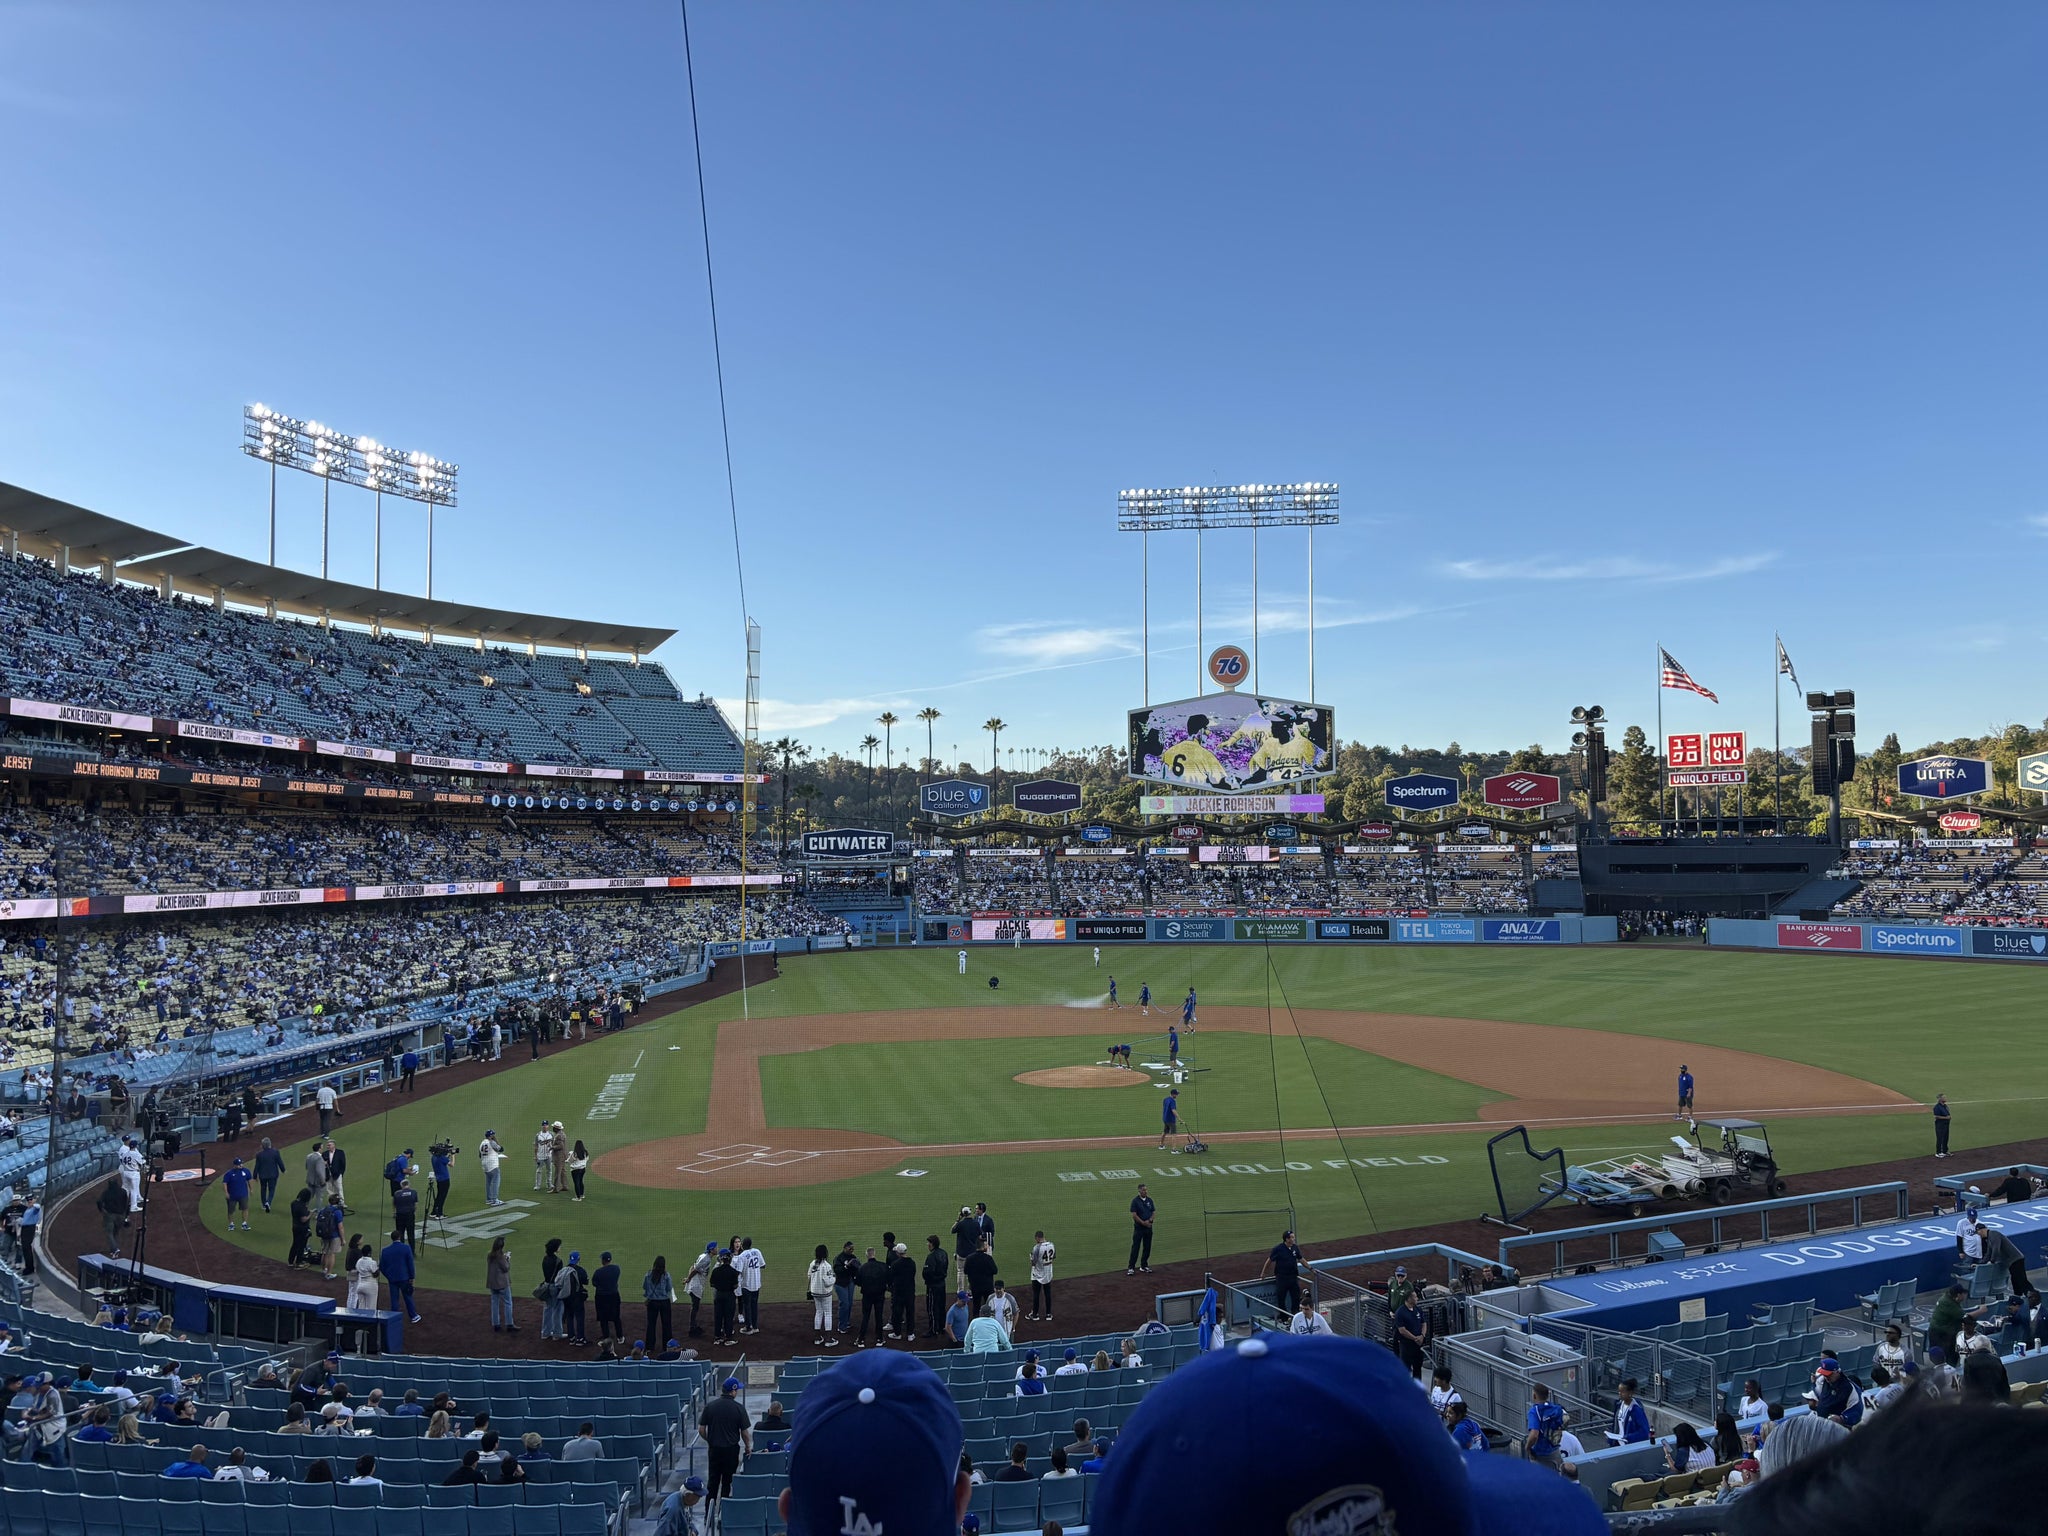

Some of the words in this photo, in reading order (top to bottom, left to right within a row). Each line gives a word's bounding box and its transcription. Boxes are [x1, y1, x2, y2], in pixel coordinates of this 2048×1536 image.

[1216, 656, 1241, 675] 76
[58, 707, 81, 721] JACKIE
[81, 709, 112, 725] ROBINSON
[182, 724, 205, 737] JACKIE
[204, 726, 234, 740] ROBINSON
[1672, 738, 1697, 750] ユニ
[1713, 736, 1737, 748] UNI
[343, 746, 357, 757] JACKIE
[356, 748, 373, 758] ROBINSON
[1672, 751, 1698, 762] クロ
[1714, 750, 1740, 762] QLO
[2, 756, 33, 770] JERSEY
[414, 755, 429, 765] JACKIE
[428, 757, 451, 768] ROBINSON
[1172, 754, 1187, 777] 6
[73, 762, 99, 776] JACKIE
[99, 764, 134, 778] ROBINSON
[134, 767, 160, 780] JERSEY
[555, 767, 570, 776] JACKIE
[571, 768, 592, 777] ROBINSON
[648, 772, 668, 780] JACKIE
[668, 773, 694, 781] ROBINSON
[1916, 768, 1968, 780] ULTRA
[190, 772, 211, 784] JACKIE
[211, 774, 240, 787] ROBINSON
[239, 776, 262, 788] JERSEY
[1673, 775, 1709, 785] UNIQLO
[1712, 773, 1742, 782] FIELD
[287, 781, 304, 792] JACKIE
[327, 784, 345, 795] JERSEY
[927, 787, 965, 802] blue
[1392, 786, 1448, 799] Spectrum
[1019, 793, 1077, 801] GUGGENHEIM
[1186, 797, 1223, 811] JACKIE
[1223, 797, 1276, 811] ROBINSON
[1942, 816, 1979, 828] Churu
[808, 836, 887, 851] CUTWATER
[1218, 846, 1246, 854] JACKIE
[1217, 853, 1247, 861] ROBINSON
[537, 881, 550, 890] JACKIE
[608, 879, 623, 888] JACKIE
[258, 892, 277, 904] JACKIE
[276, 890, 301, 903] ROBINSON
[382, 886, 401, 898] JACKIE
[400, 885, 425, 896] ROBINSON
[155, 896, 177, 911] JACKIE
[177, 894, 207, 909] ROBINSON
[996, 920, 1030, 930] JACKIE
[1093, 926, 1121, 935] UNIQLO
[1121, 926, 1144, 934] FIELD
[1183, 921, 1213, 932] Security
[1325, 926, 1347, 934] UCLA
[1351, 925, 1384, 935] Health
[1399, 923, 1434, 938] TEL
[1498, 923, 1530, 934] ANA
[1785, 924, 1806, 932] BANK
[1817, 925, 1853, 933] AMERICA
[950, 928, 962, 937] 76
[994, 929, 1031, 940] ROBINON
[1876, 930, 1951, 948] Spectrum
[1994, 933, 2029, 949] blue
[1152, 1161, 1313, 1178] UNIQLO
[1321, 1154, 1450, 1170] FIELD
[1042, 1248, 1054, 1262] 42
[1672, 1262, 1748, 1280] ようこそ
[1760, 1225, 1957, 1267] DODGER
[748, 1257, 760, 1270] 42
[838, 1495, 884, 1536] LA
